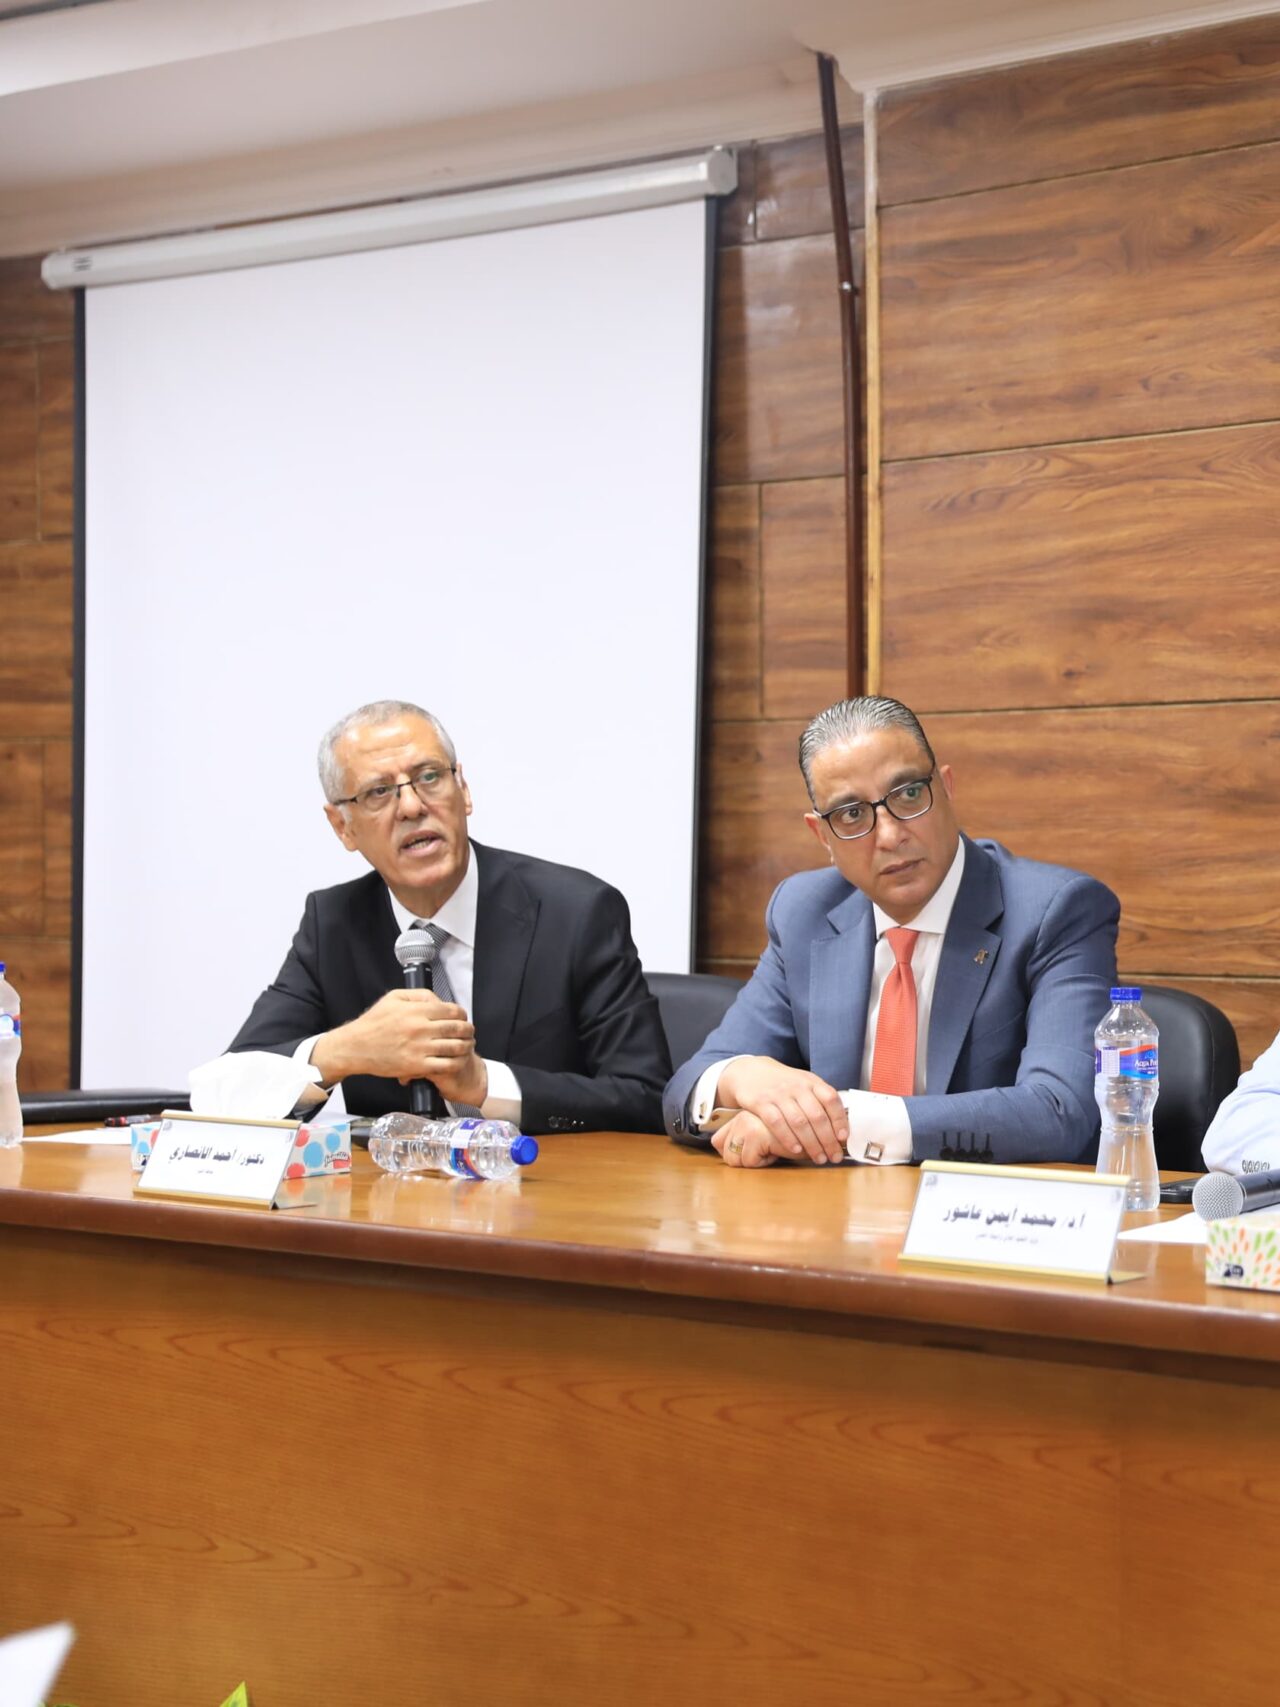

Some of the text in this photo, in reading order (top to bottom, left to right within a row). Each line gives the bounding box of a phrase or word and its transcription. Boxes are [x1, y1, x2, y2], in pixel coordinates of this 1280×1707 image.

[942, 1203, 982, 1223] عاشور
[986, 1203, 1018, 1228] أيمن
[1021, 1213, 1057, 1227] محمد
